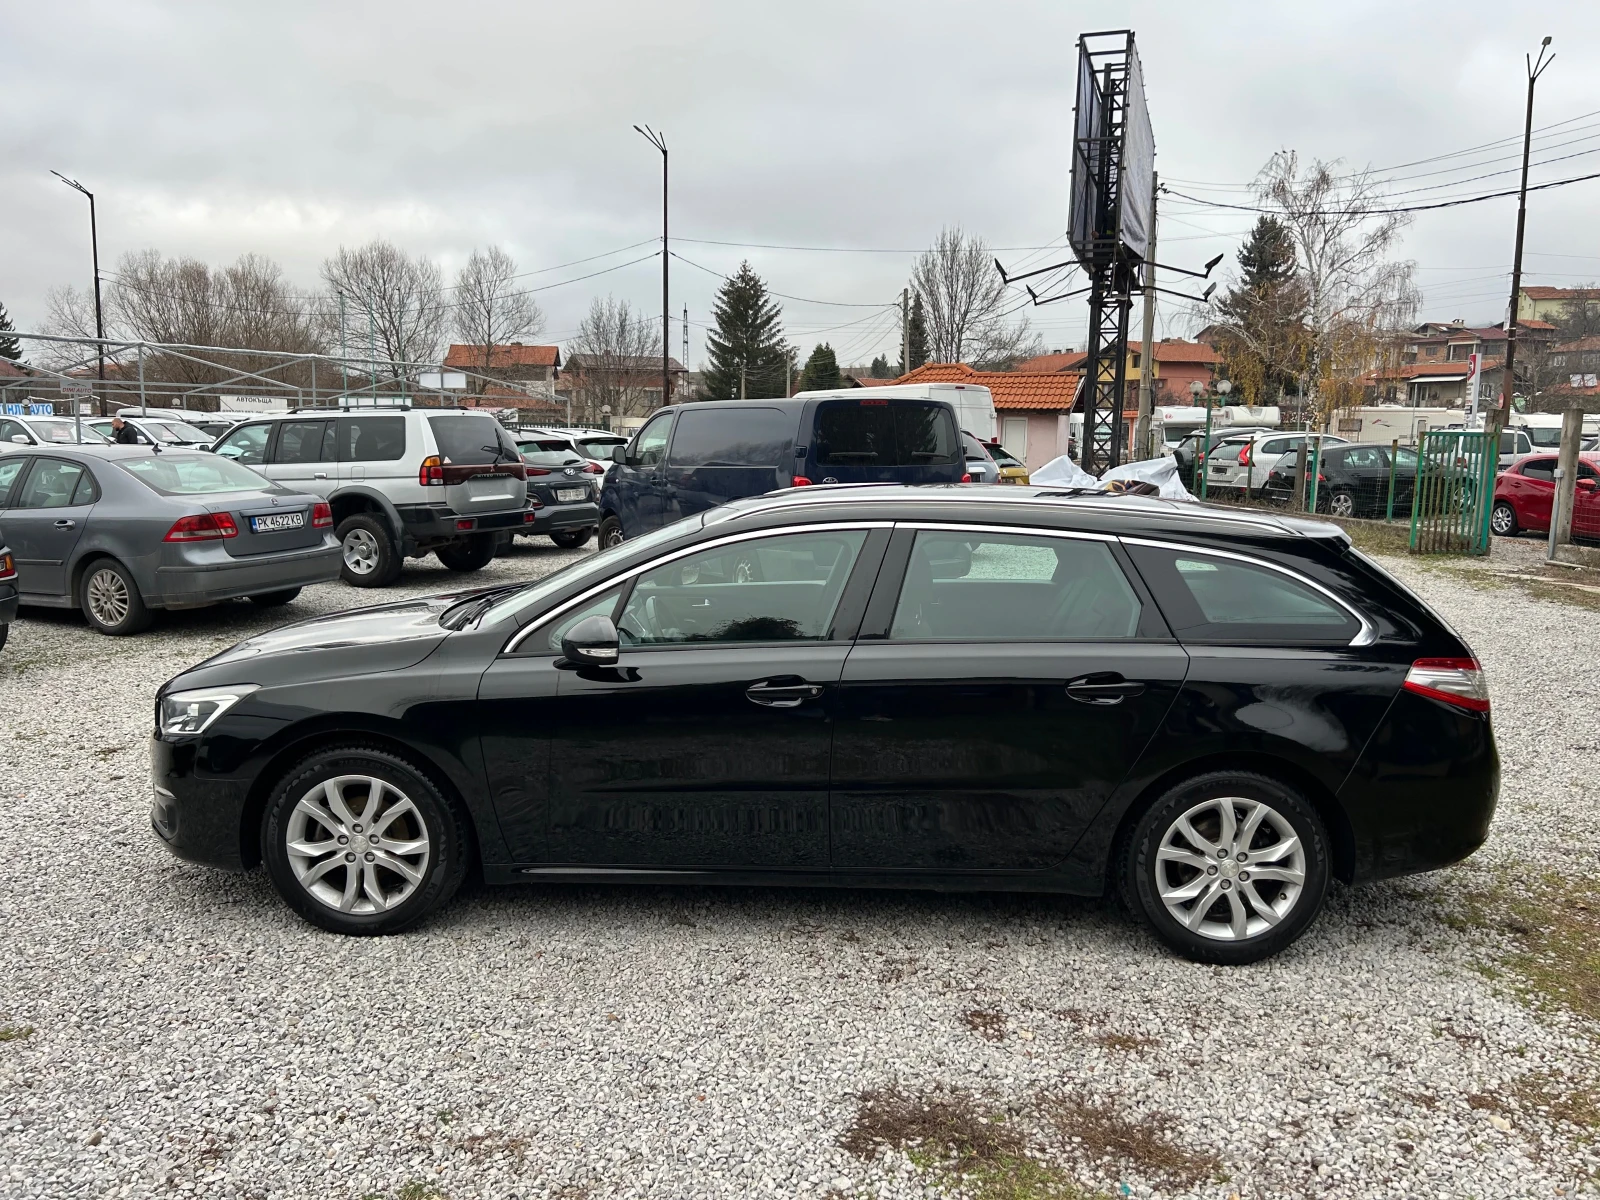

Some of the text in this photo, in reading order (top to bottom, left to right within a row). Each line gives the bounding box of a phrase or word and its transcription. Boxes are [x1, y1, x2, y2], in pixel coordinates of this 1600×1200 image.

[30, 404, 52, 414] АУТО
[257, 515, 302, 528] PK 4622 KB
